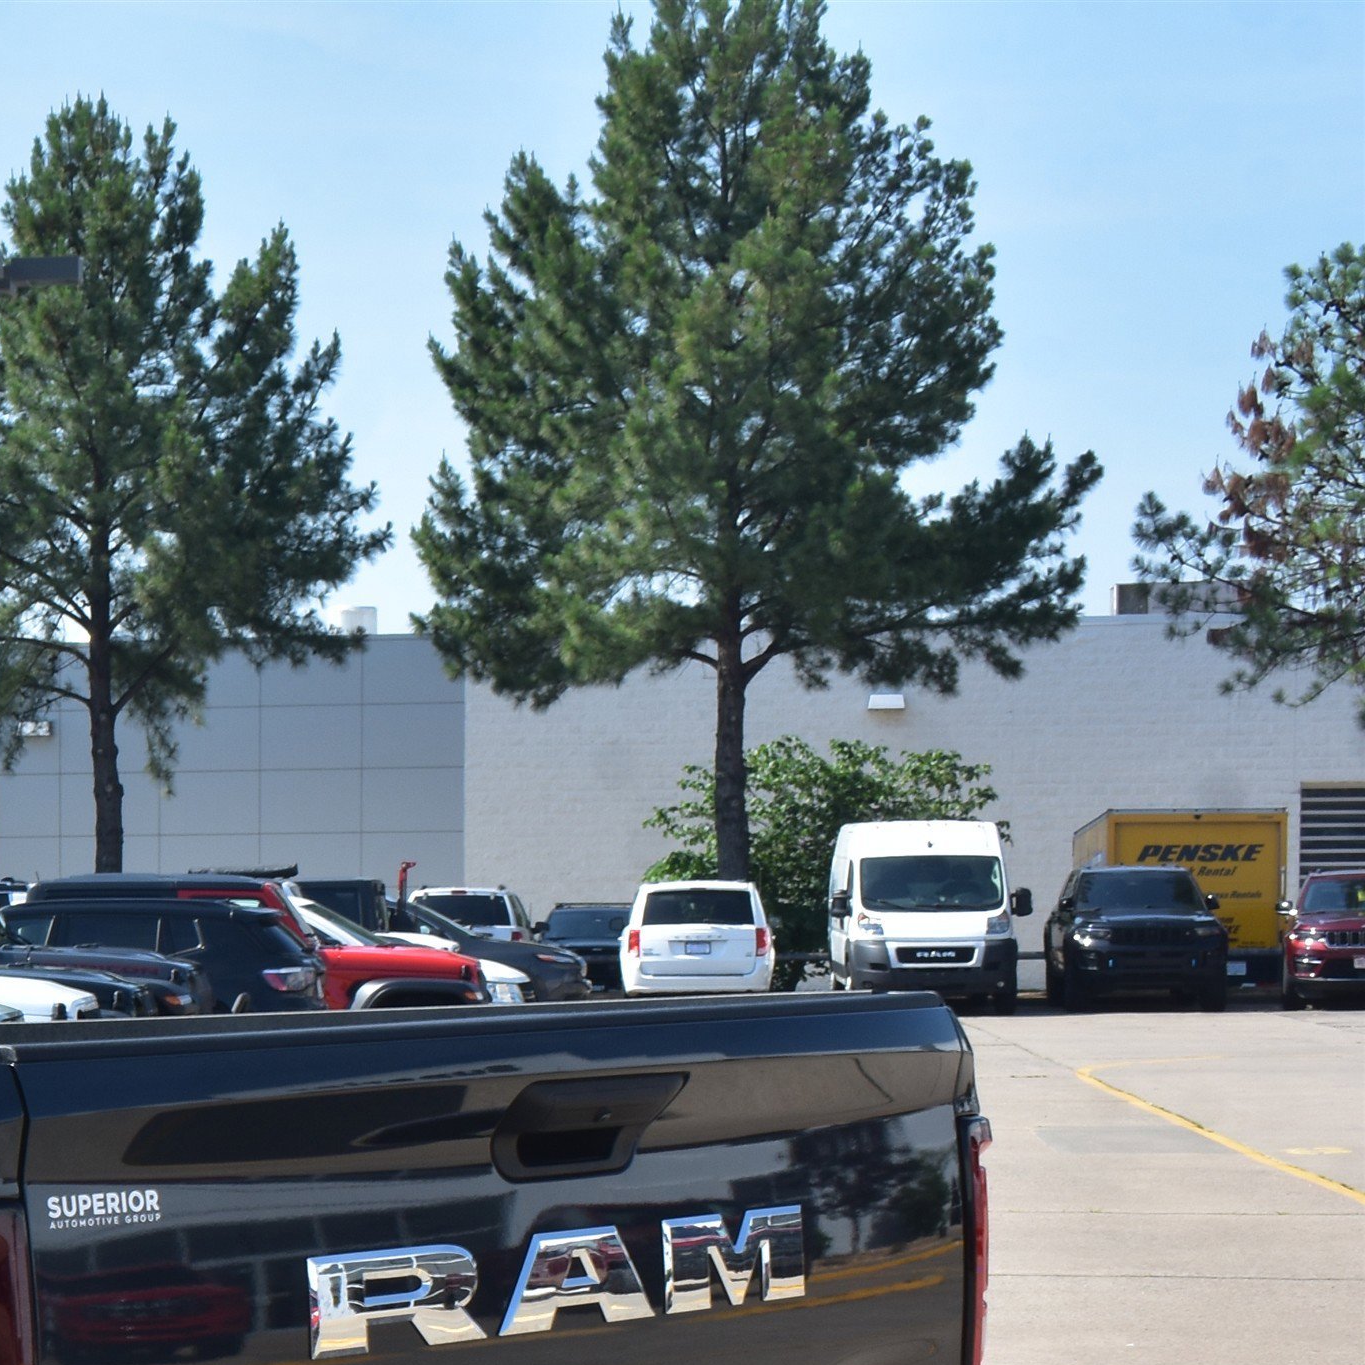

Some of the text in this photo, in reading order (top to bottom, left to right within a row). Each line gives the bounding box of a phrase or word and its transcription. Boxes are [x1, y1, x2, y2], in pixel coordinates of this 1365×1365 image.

[1137, 844, 1266, 862] PENSKE
[1197, 866, 1237, 877] Rental
[47, 1189, 160, 1219] SUPERIOR
[49, 1213, 162, 1229] AUTOMOTIVE GROUP
[307, 1204, 806, 1360] RAM
